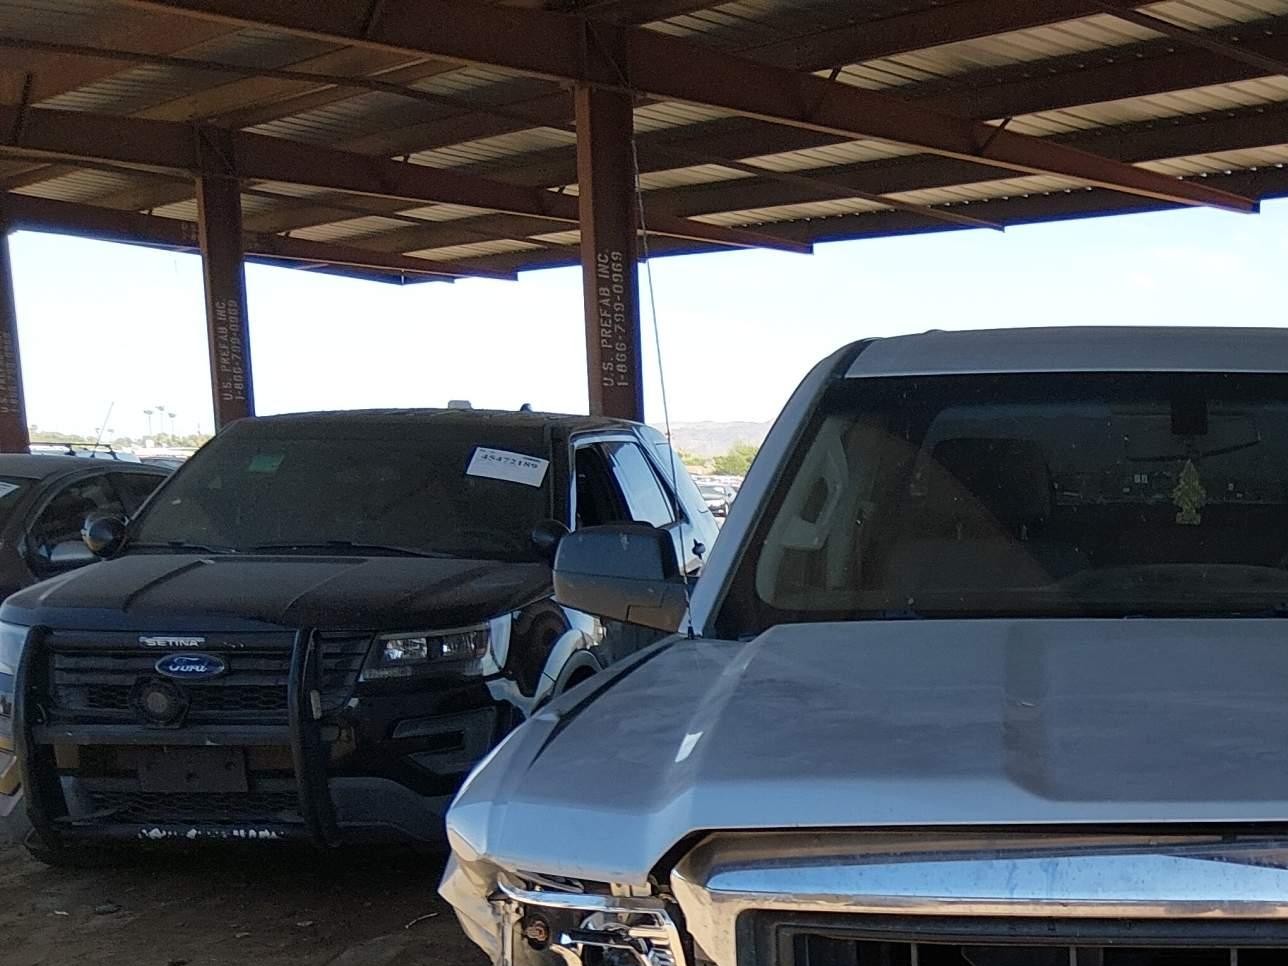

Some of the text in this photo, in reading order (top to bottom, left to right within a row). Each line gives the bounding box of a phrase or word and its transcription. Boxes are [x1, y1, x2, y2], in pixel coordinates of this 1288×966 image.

[597, 250, 615, 387] U.S. PREFAB INC.
[611, 251, 629, 387] 1-866-799-0969
[146, 638, 200, 647] SETINA
[168, 656, 208, 673] Ford
